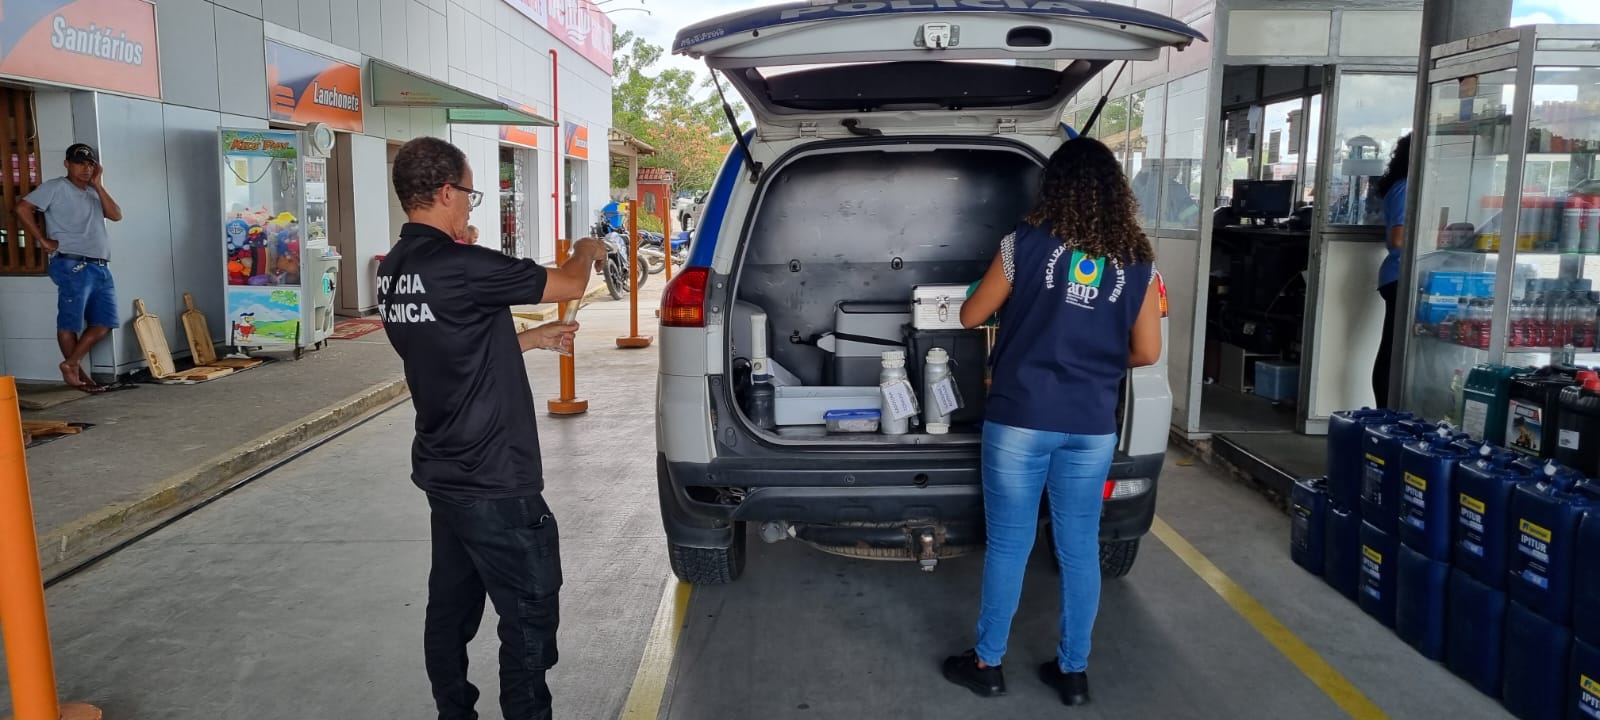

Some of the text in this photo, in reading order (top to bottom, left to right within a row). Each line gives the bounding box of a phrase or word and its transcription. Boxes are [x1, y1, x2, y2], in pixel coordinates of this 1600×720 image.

[52, 15, 143, 65] Sanitários
[313, 81, 359, 112] Lanchonete
[1045, 239, 1080, 289] FISCALIZA
[377, 273, 426, 295] POCIA
[1108, 253, 1126, 302] STÍVEIS
[1067, 281, 1099, 303] anp
[1460, 506, 1482, 524] IPITUR
[1521, 533, 1547, 553] IPITUR
[1582, 690, 1600, 711] IPIT
